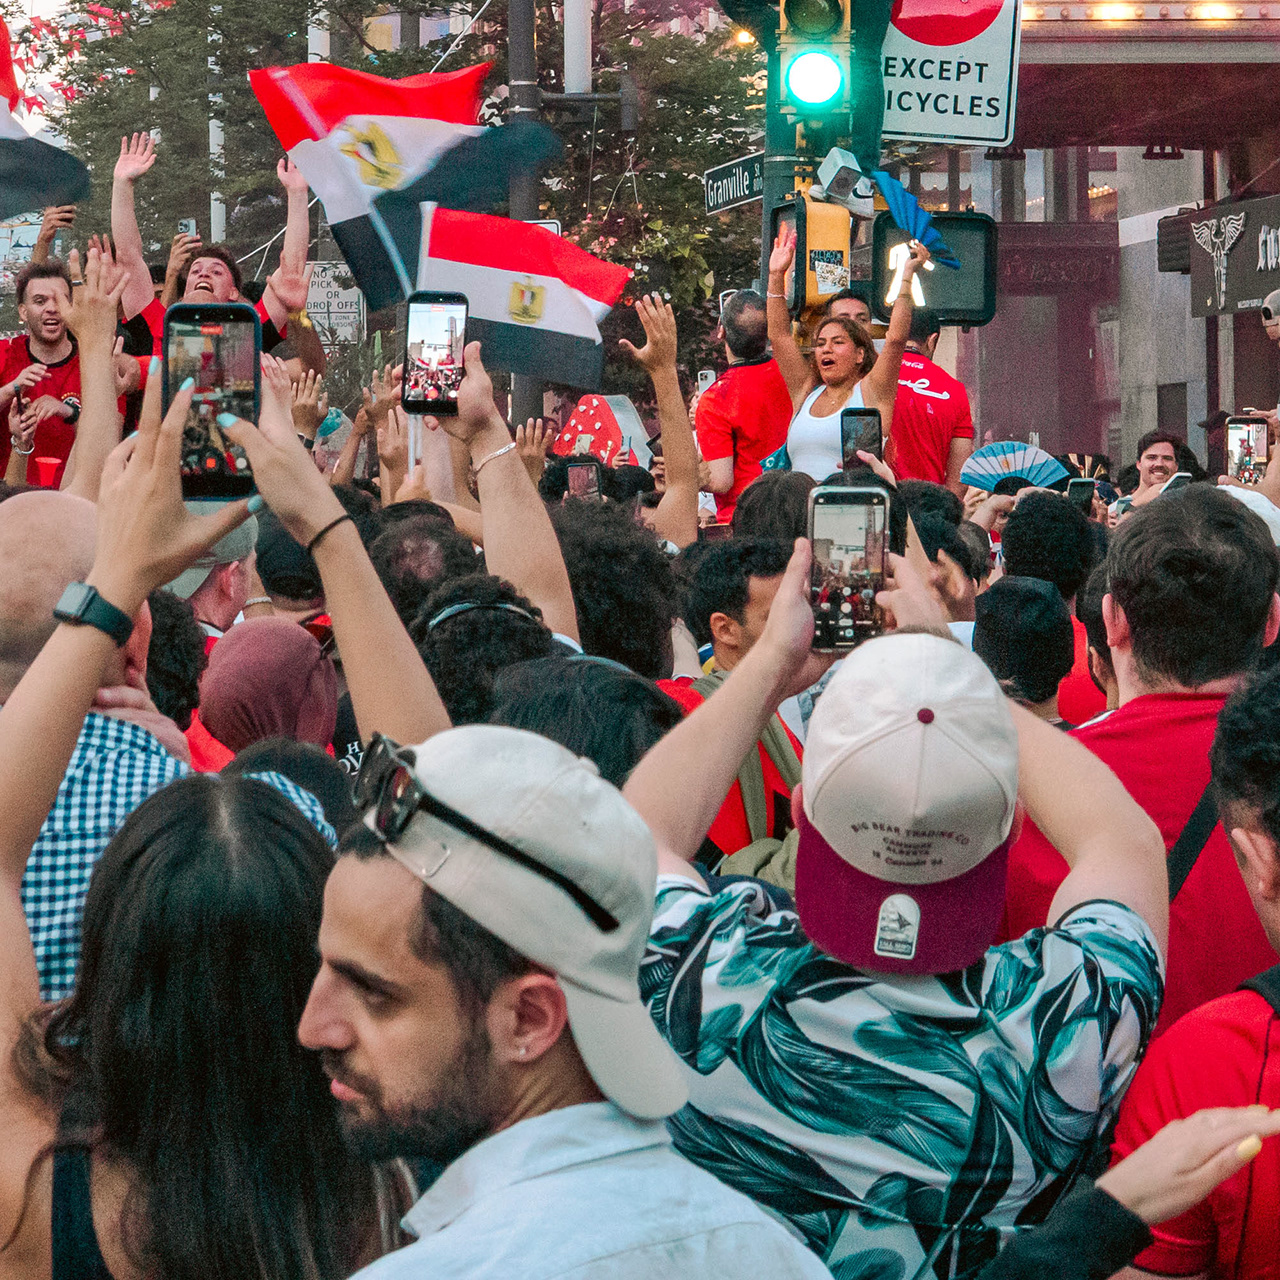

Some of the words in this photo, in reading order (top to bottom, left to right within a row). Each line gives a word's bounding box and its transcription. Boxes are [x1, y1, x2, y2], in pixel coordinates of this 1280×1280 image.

[884, 56, 989, 83] EXCEPT
[887, 90, 1001, 118] ICYCLES
[707, 166, 750, 207] Granville
[313, 270, 327, 279] NO
[333, 270, 350, 278] TAX
[310, 280, 332, 289] PICK
[326, 290, 340, 299] OR
[306, 301, 332, 310] DROP
[337, 301, 359, 310] OFFS
